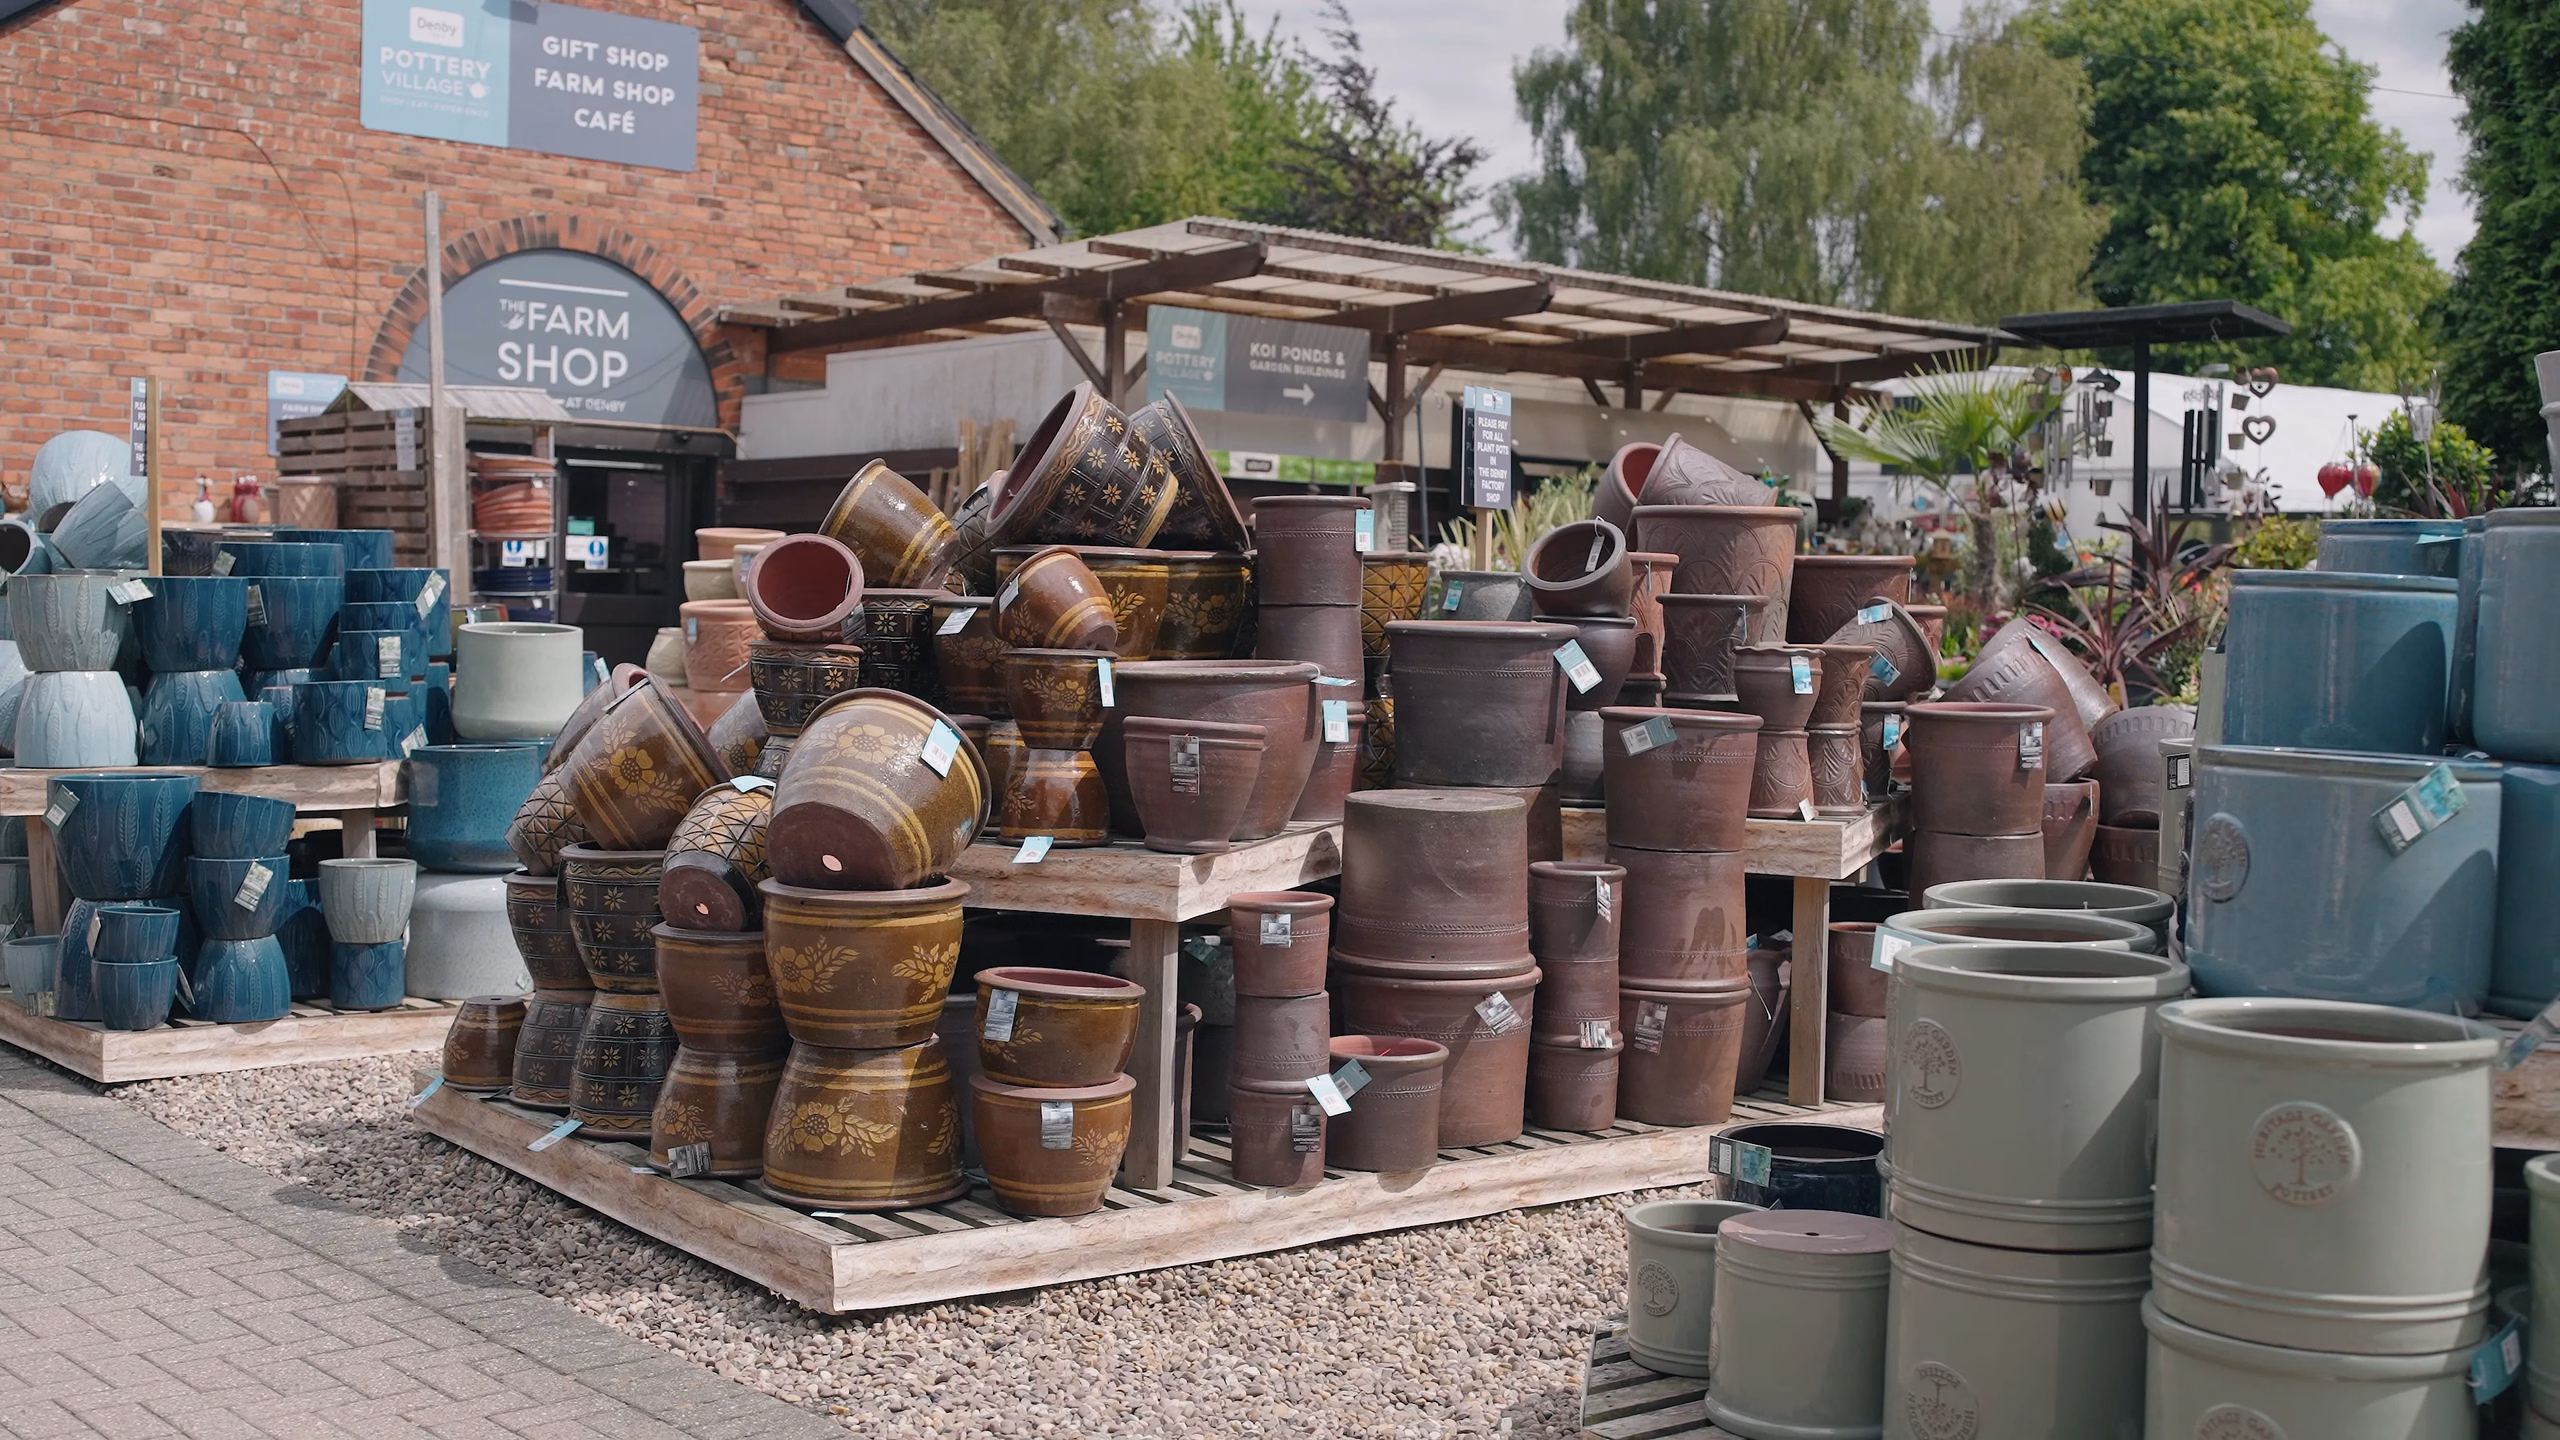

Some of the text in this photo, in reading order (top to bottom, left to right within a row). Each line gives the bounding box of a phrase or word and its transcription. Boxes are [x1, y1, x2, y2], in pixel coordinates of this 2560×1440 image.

[416, 16, 457, 36] Denby
[379, 46, 491, 80] POTTERY
[542, 36, 669, 72] GIFT SHOP
[381, 70, 464, 96] VILLAGE
[534, 68, 675, 107] FARM SHOP
[574, 108, 636, 134] CAFÉ
[499, 298, 629, 340] THE FARM
[1155, 351, 1216, 369] POTTERY
[1250, 342, 1346, 366] KOI PONDS &
[498, 341, 629, 389] SHOP
[1157, 366, 1201, 381] VILLAGE
[1249, 359, 1347, 379] GARDEN BUILDINGS
[565, 396, 628, 413] AT DENBY
[1478, 416, 1498, 429] PLEASE
[1498, 419, 1508, 430] PAY
[1482, 430, 1504, 442] FOR ALL
[1477, 441, 1496, 453] PLANT
[1495, 444, 1509, 455] POTS
[1489, 456, 1497, 466] IN
[1478, 466, 1489, 478] THE
[1490, 469, 1508, 480] DENBY
[1481, 479, 1505, 491] FACTORY
[1485, 492, 1501, 503] SHOP
